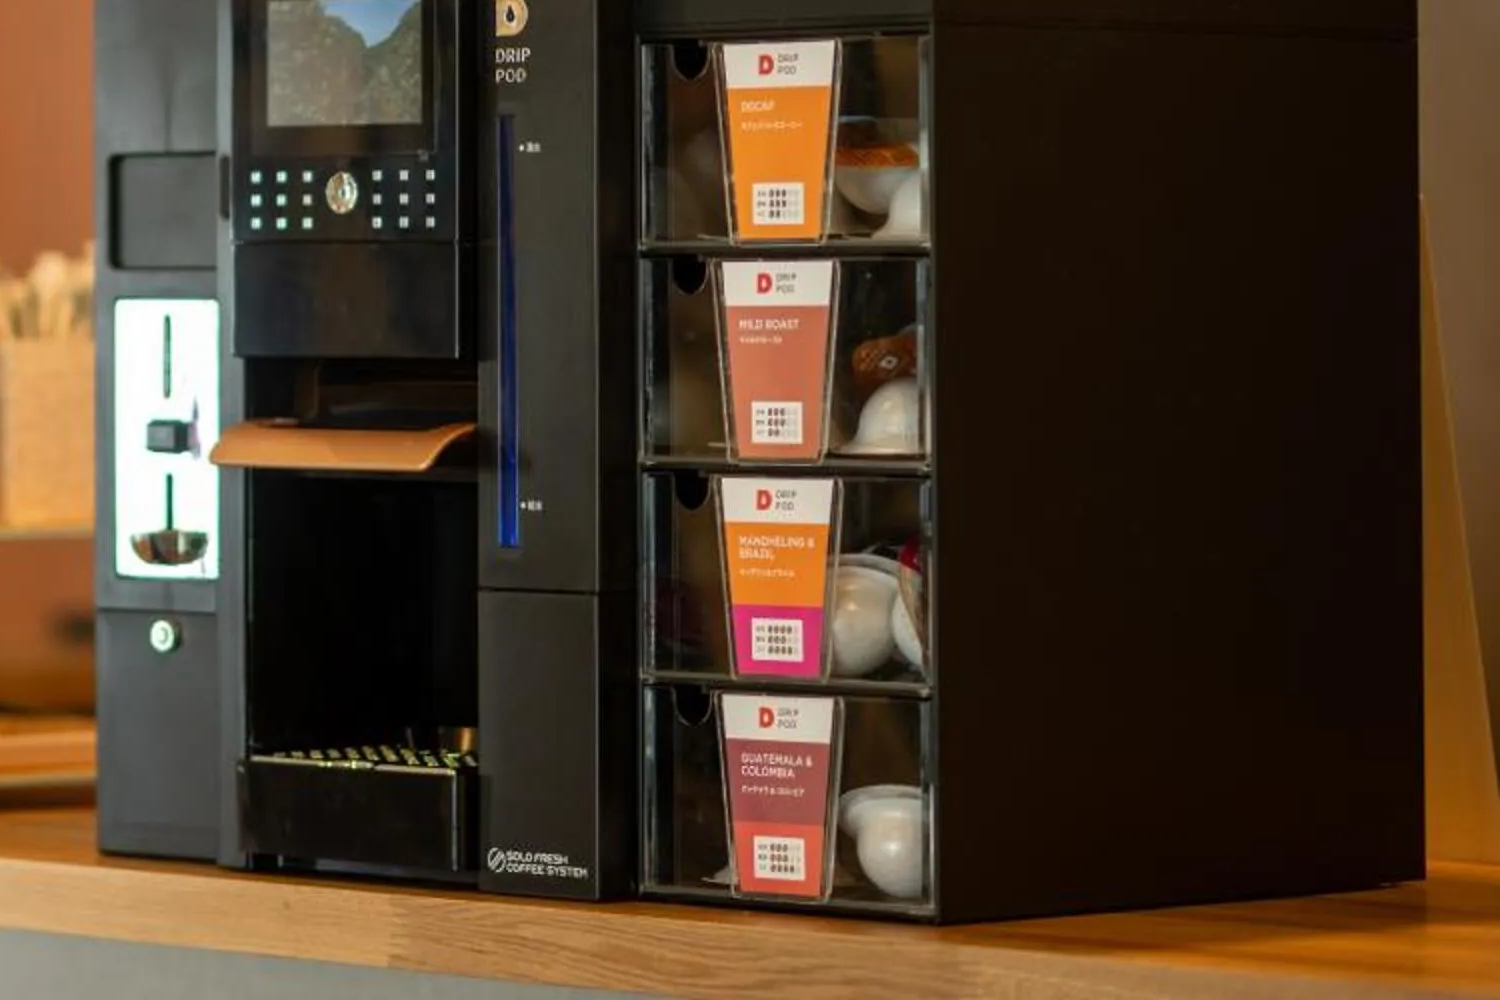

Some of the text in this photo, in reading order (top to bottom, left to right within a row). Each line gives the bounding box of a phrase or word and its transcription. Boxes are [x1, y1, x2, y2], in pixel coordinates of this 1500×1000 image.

[495, 48, 531, 64] DRIP
[777, 53, 799, 63] DRIP
[495, 68, 527, 83] POD
[777, 65, 797, 75] POD
[739, 318, 799, 330] MILD ROAST
[739, 535, 805, 549] MANDHELING
[741, 753, 803, 767] GUATEMALA
[741, 765, 795, 778] COLOMBIA
[506, 851, 569, 865] SOLO FRESH
[506, 863, 589, 879] COFFEE SYSTEM
